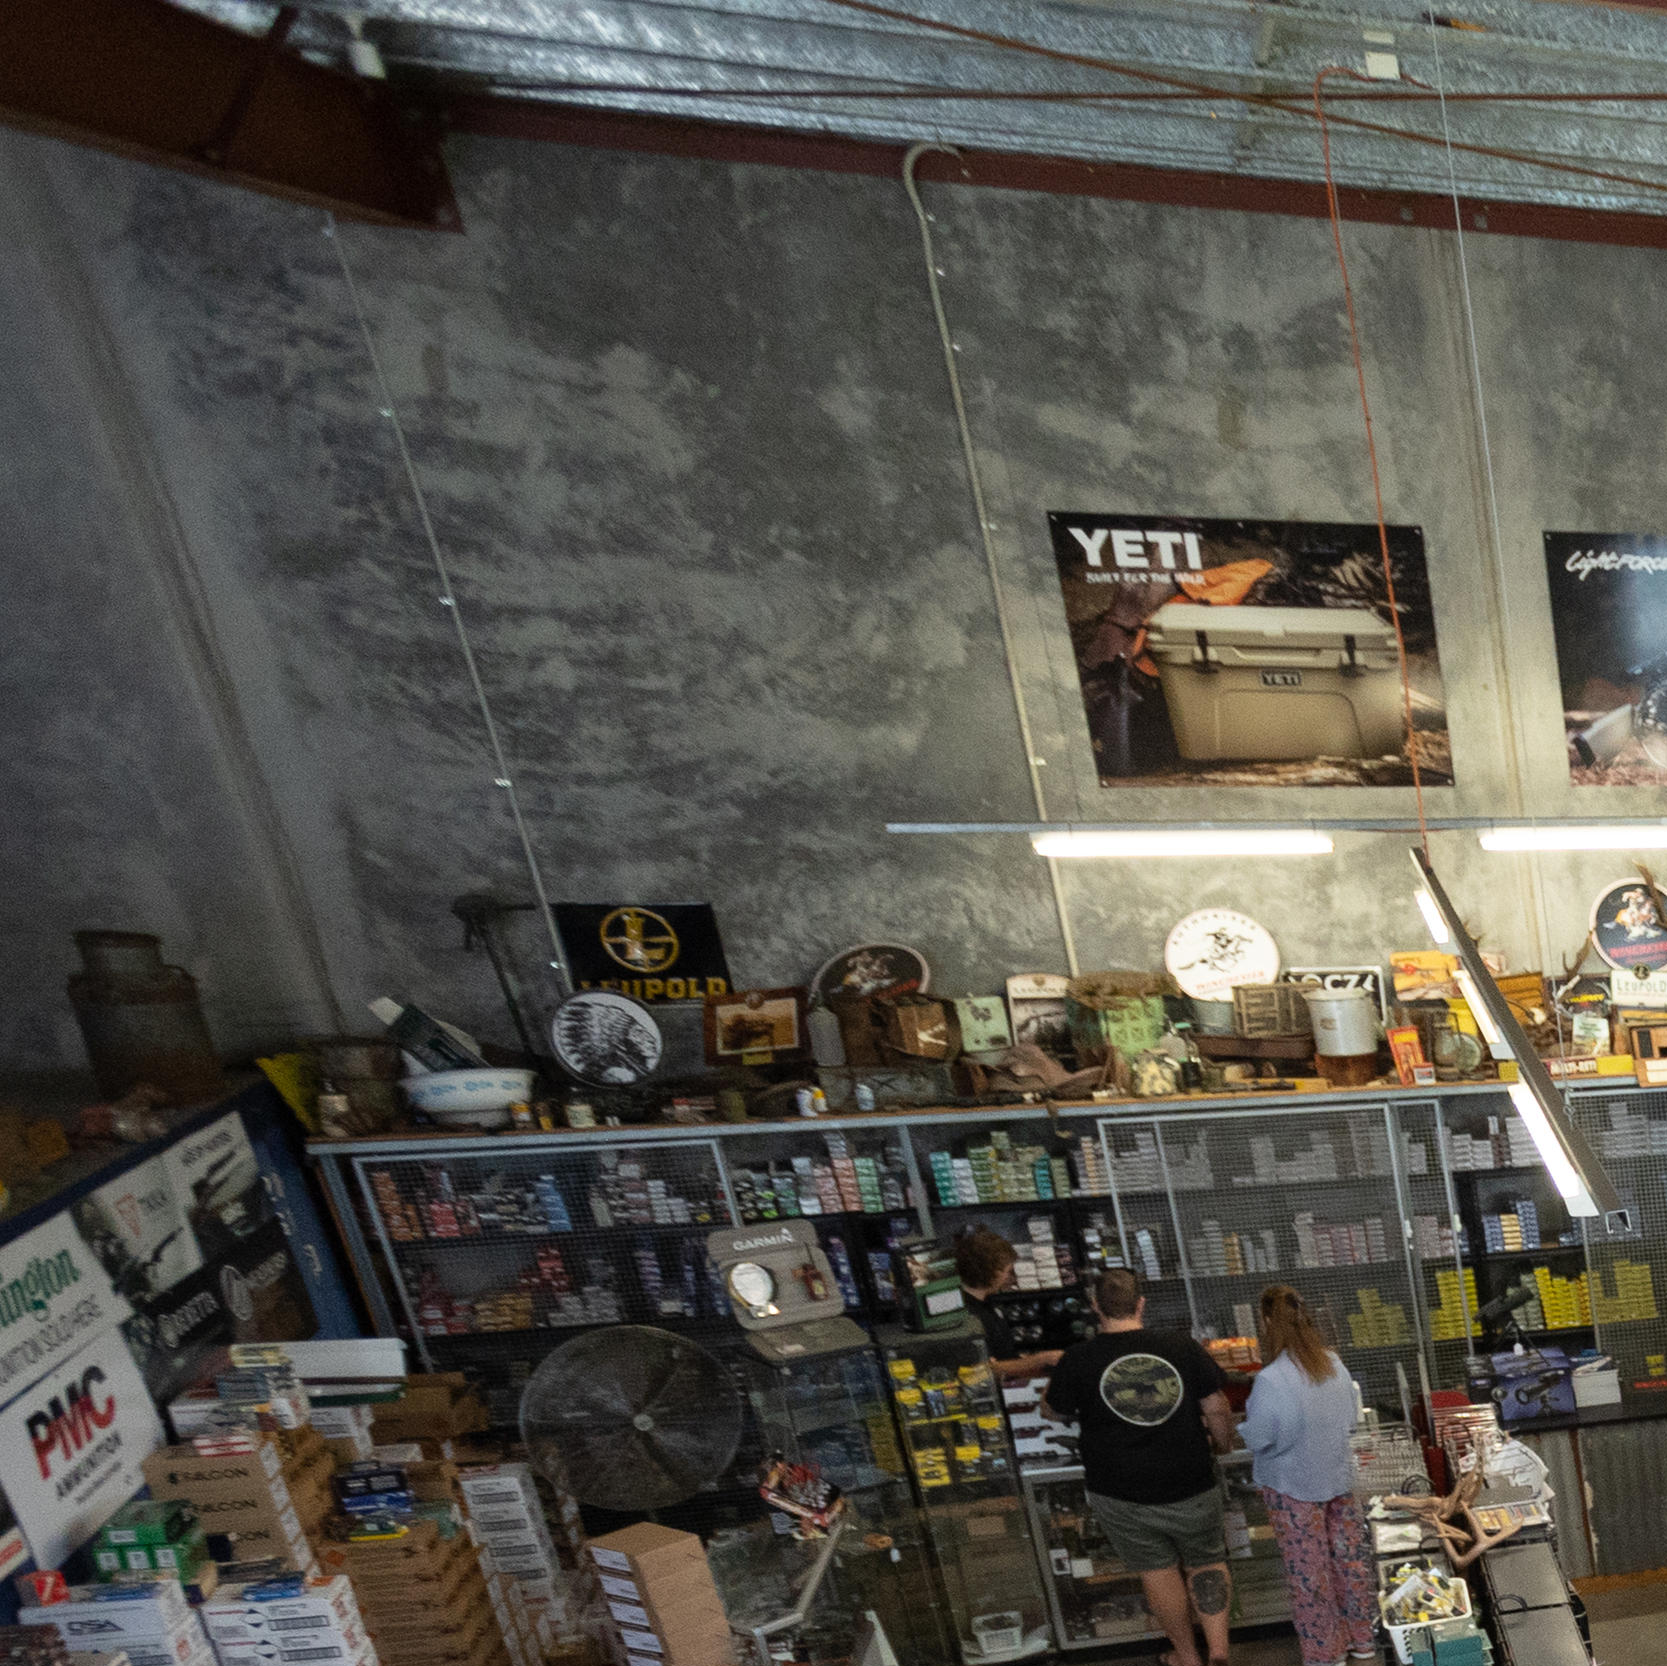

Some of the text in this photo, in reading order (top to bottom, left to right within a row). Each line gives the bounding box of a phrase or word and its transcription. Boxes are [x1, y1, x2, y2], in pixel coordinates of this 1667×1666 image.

[1067, 528, 1202, 570] YETI
[1263, 672, 1300, 686] YETI
[1616, 979, 1667, 994] LEUPOLD
[733, 1228, 793, 1251] GARMIN
[25, 1366, 115, 1481] PMC
